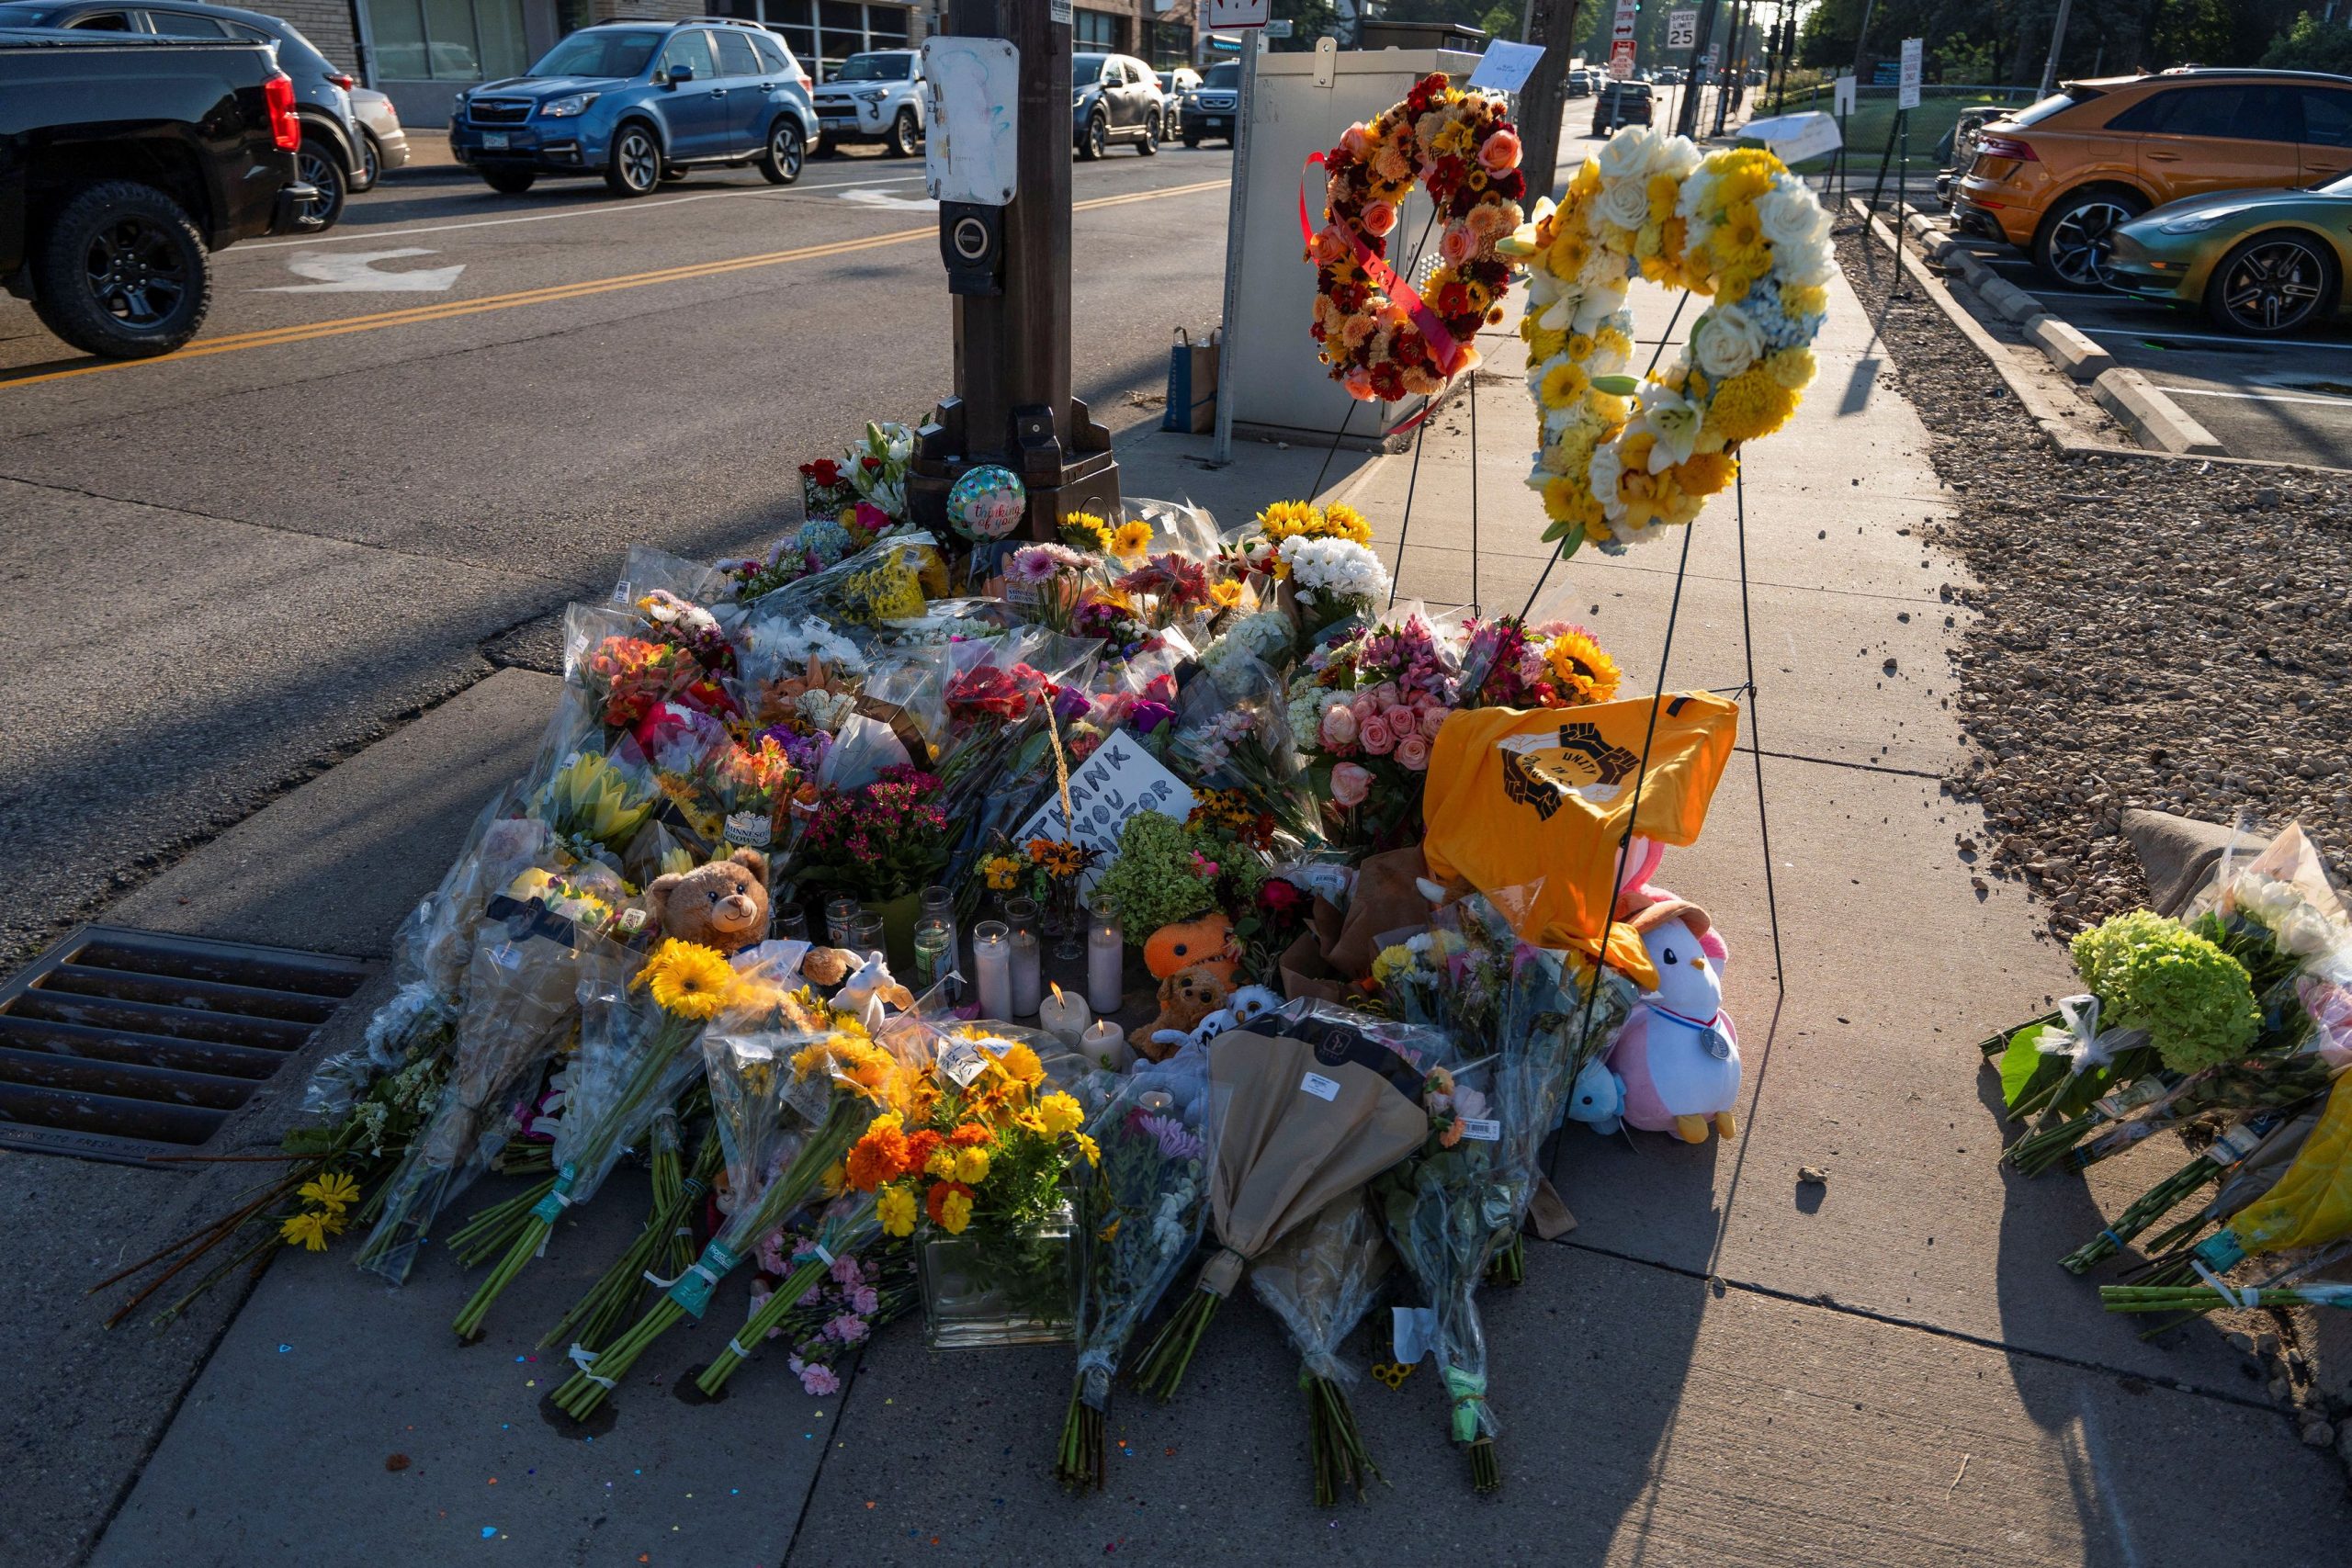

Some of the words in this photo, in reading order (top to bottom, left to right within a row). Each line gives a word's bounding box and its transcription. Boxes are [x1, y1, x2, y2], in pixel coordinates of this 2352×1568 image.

[1672, 21, 1691, 29] LIMIT
[1669, 30, 1693, 44] 25
[975, 504, 1021, 519] thinking
[978, 515, 991, 530] of
[995, 517, 1013, 531] you
[1563, 752, 1597, 774] UNITY
[1024, 745, 1131, 842] THANK
[1073, 788, 1125, 837] YOU
[725, 830, 759, 844] GROWN
